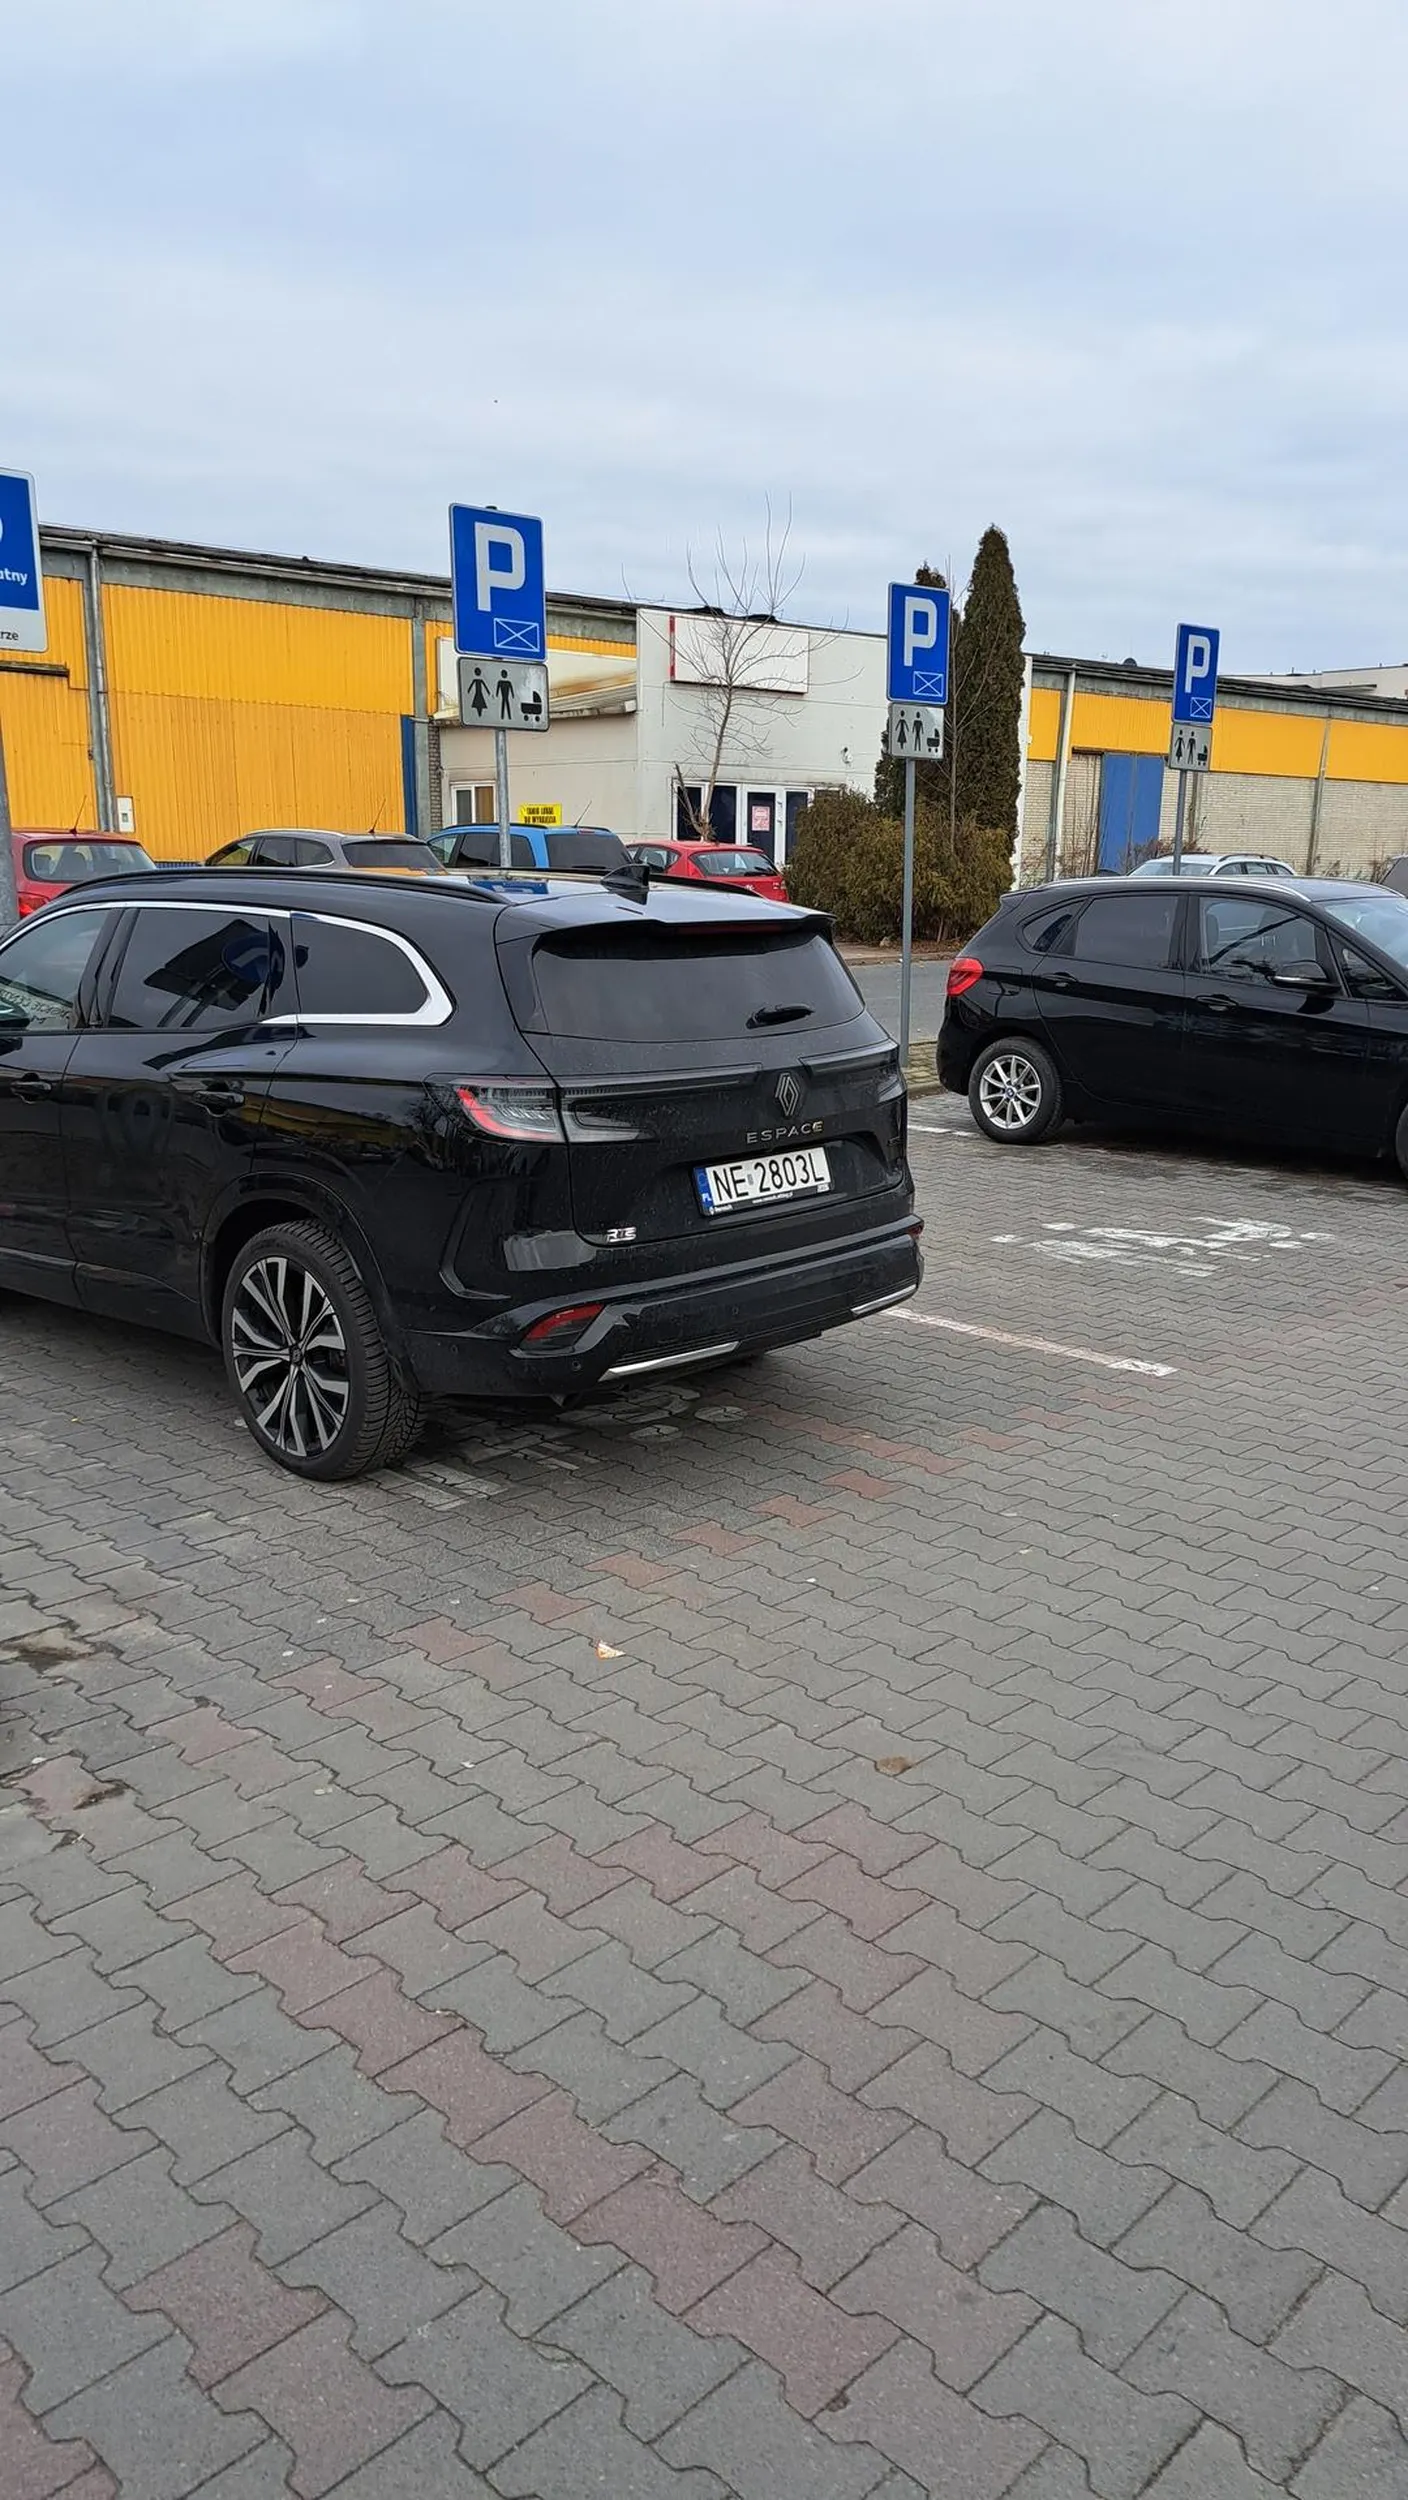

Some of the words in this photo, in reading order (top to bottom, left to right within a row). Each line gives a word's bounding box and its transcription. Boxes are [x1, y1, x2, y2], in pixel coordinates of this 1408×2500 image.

[474, 522, 525, 612] P
[904, 596, 938, 666] P
[1184, 634, 1211, 693] P
[746, 1121, 824, 1144] ESPACE
[712, 1165, 749, 1201] NE
[754, 1152, 825, 1193] 2803L
